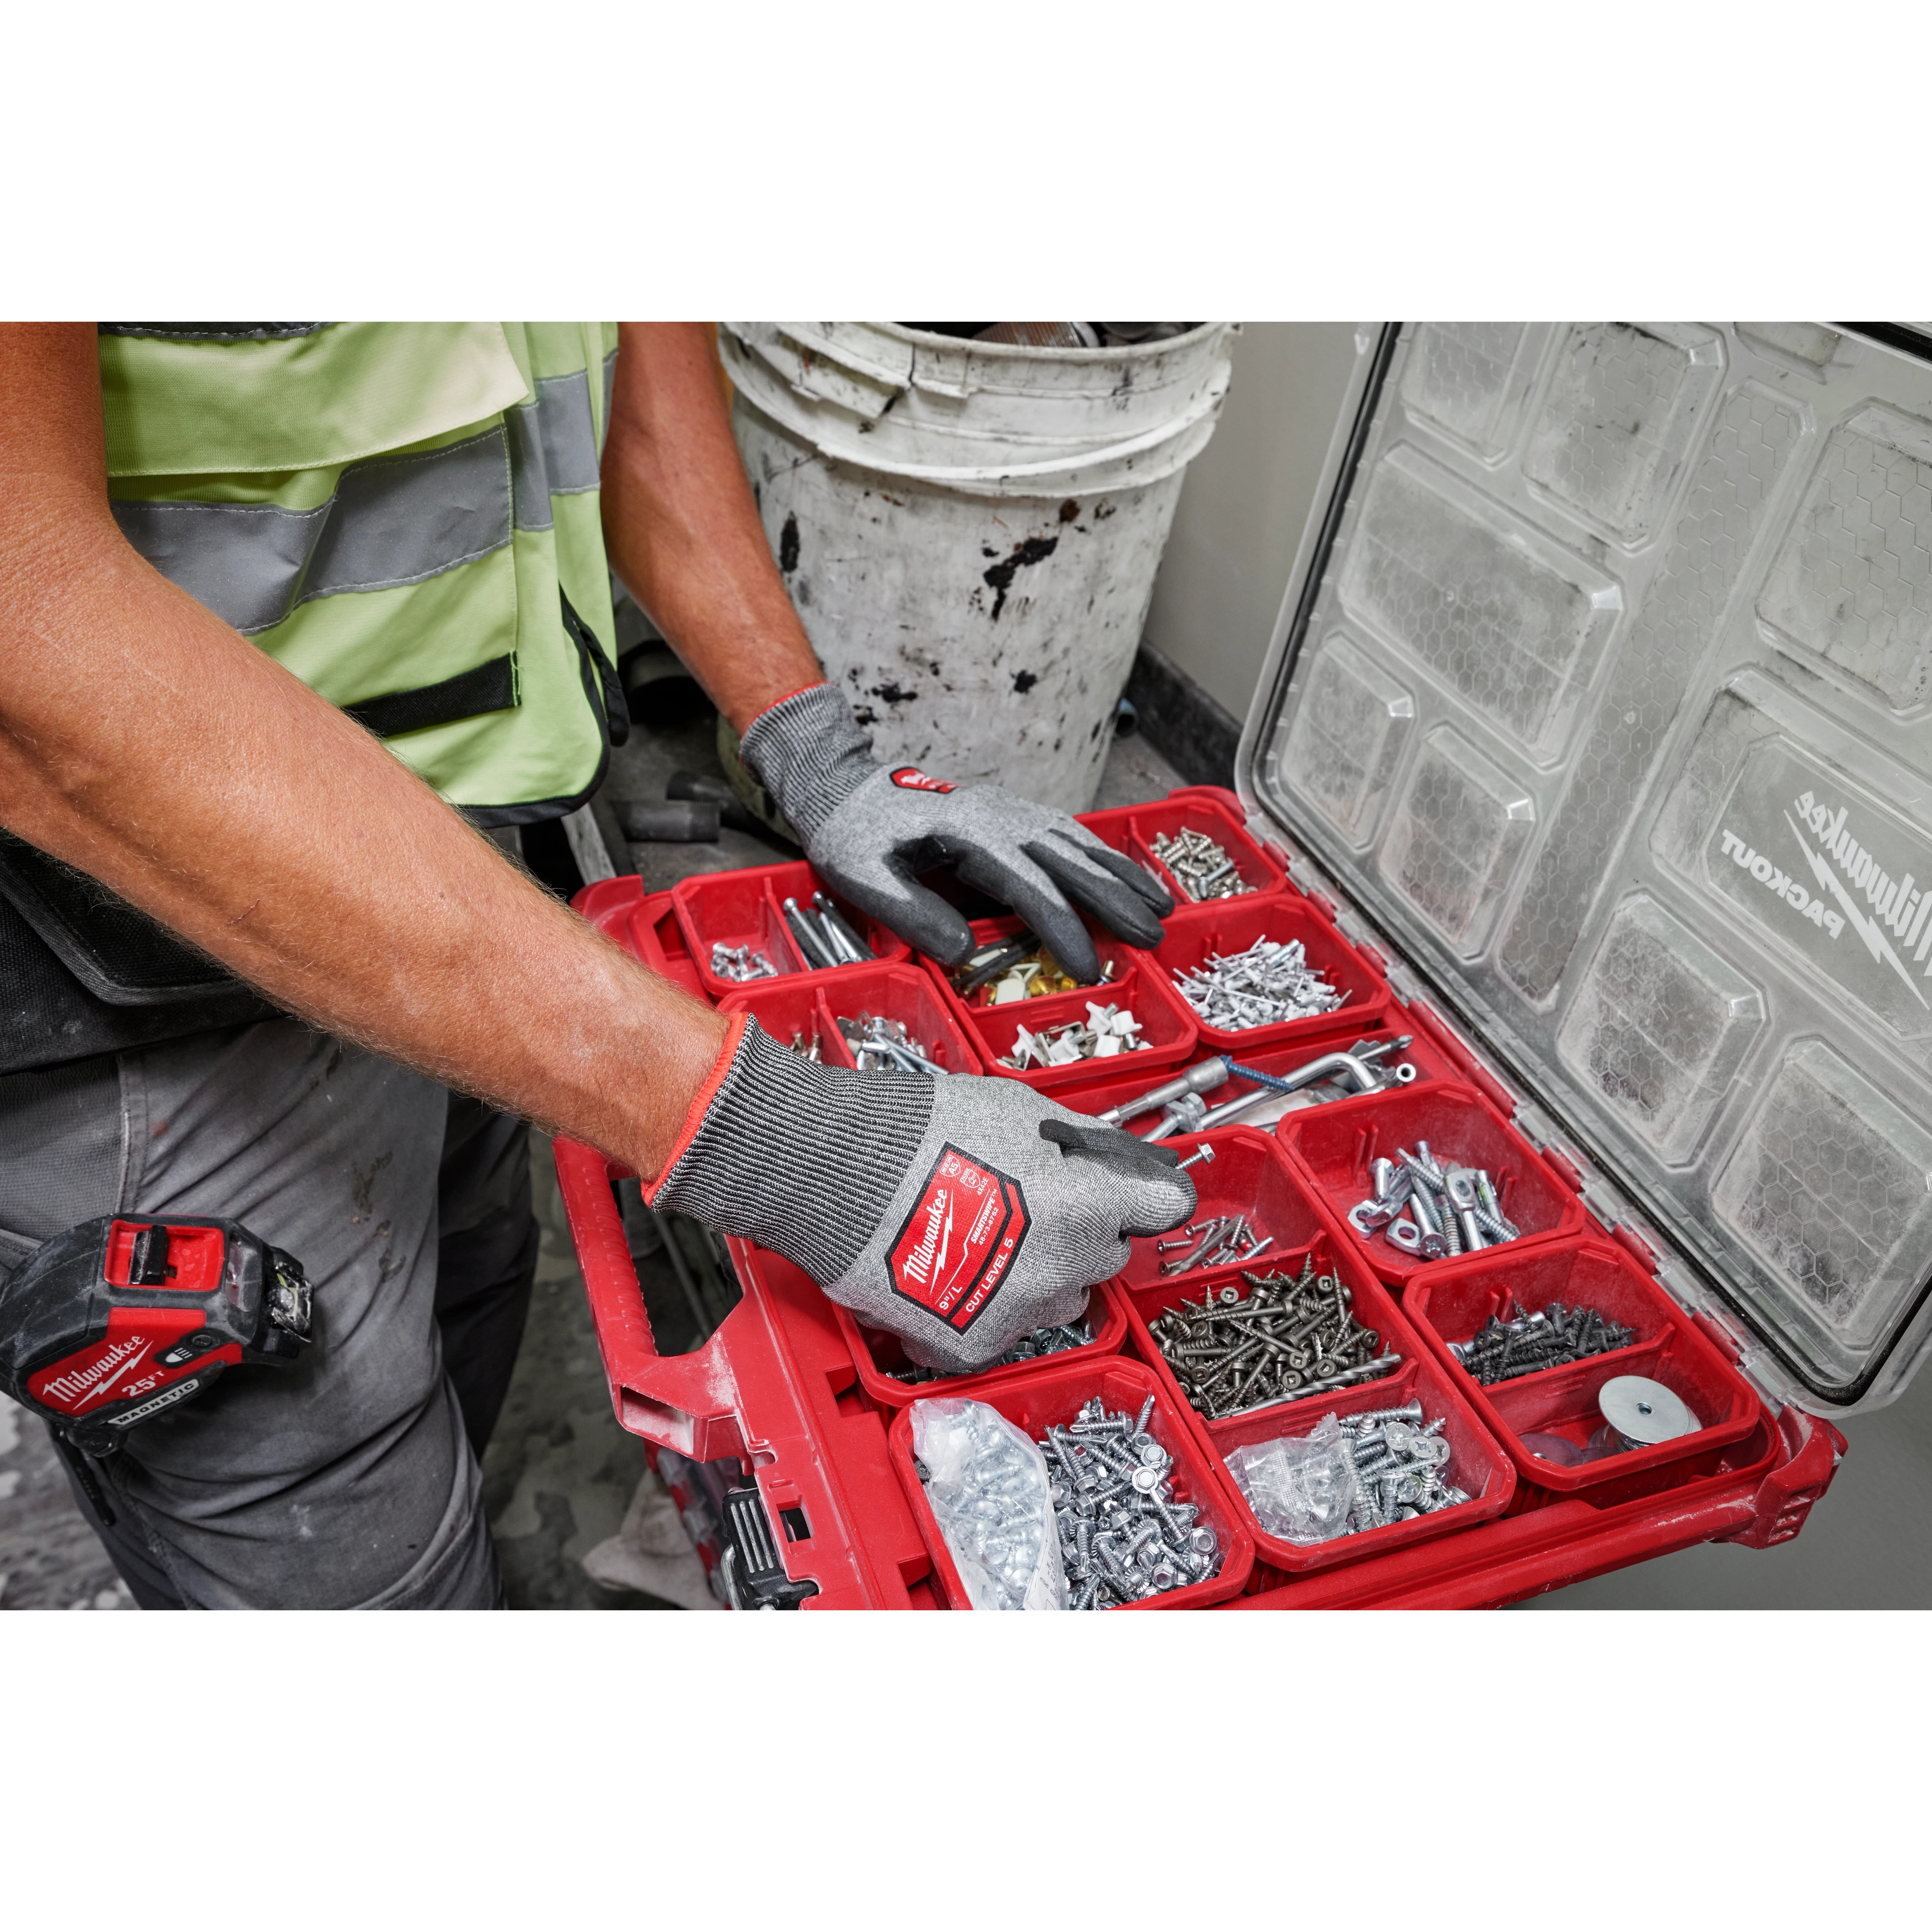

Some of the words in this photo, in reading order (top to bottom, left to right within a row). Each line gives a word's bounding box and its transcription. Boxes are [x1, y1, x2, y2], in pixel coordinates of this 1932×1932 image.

[948, 1162, 958, 1175] A5
[960, 1168, 970, 1183] EN388
[977, 1177, 989, 1195] 4X42E
[902, 1189, 947, 1284] Milwaukee
[979, 1207, 998, 1246] 48-73-8752
[966, 1289, 983, 1312] CUT
[981, 1253, 1008, 1290] LEVEL
[1003, 1237, 1013, 1249] 5
[43, 1336, 145, 1402] Milwaukee
[116, 1383, 195, 1423] MAGNETIC
